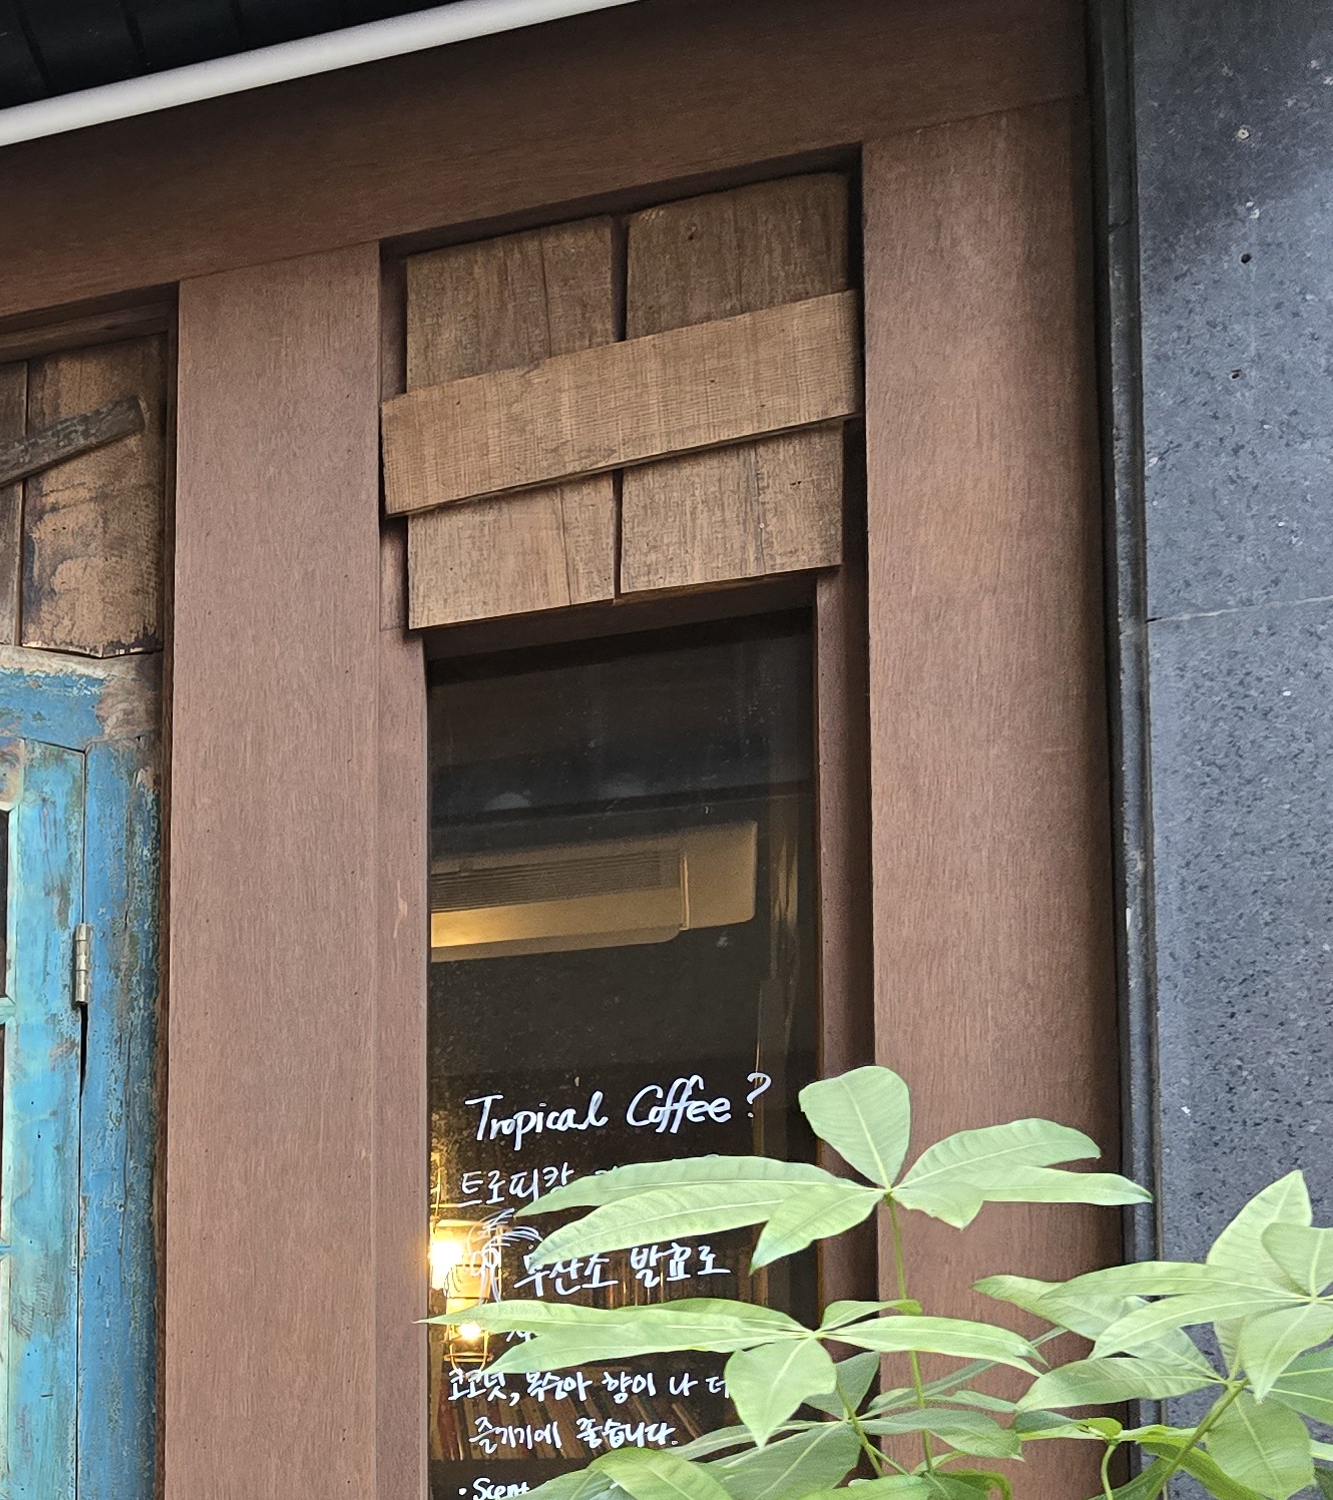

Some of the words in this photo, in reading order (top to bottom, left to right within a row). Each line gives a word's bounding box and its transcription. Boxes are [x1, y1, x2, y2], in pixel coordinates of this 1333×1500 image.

[465, 1094, 609, 1150] Tropical
[630, 1242, 732, 1289] 발효로
[602, 1371, 657, 1404] 향이
[469, 1416, 563, 1454] 즐기기에
[576, 1417, 679, 1449] 좋습니다.
